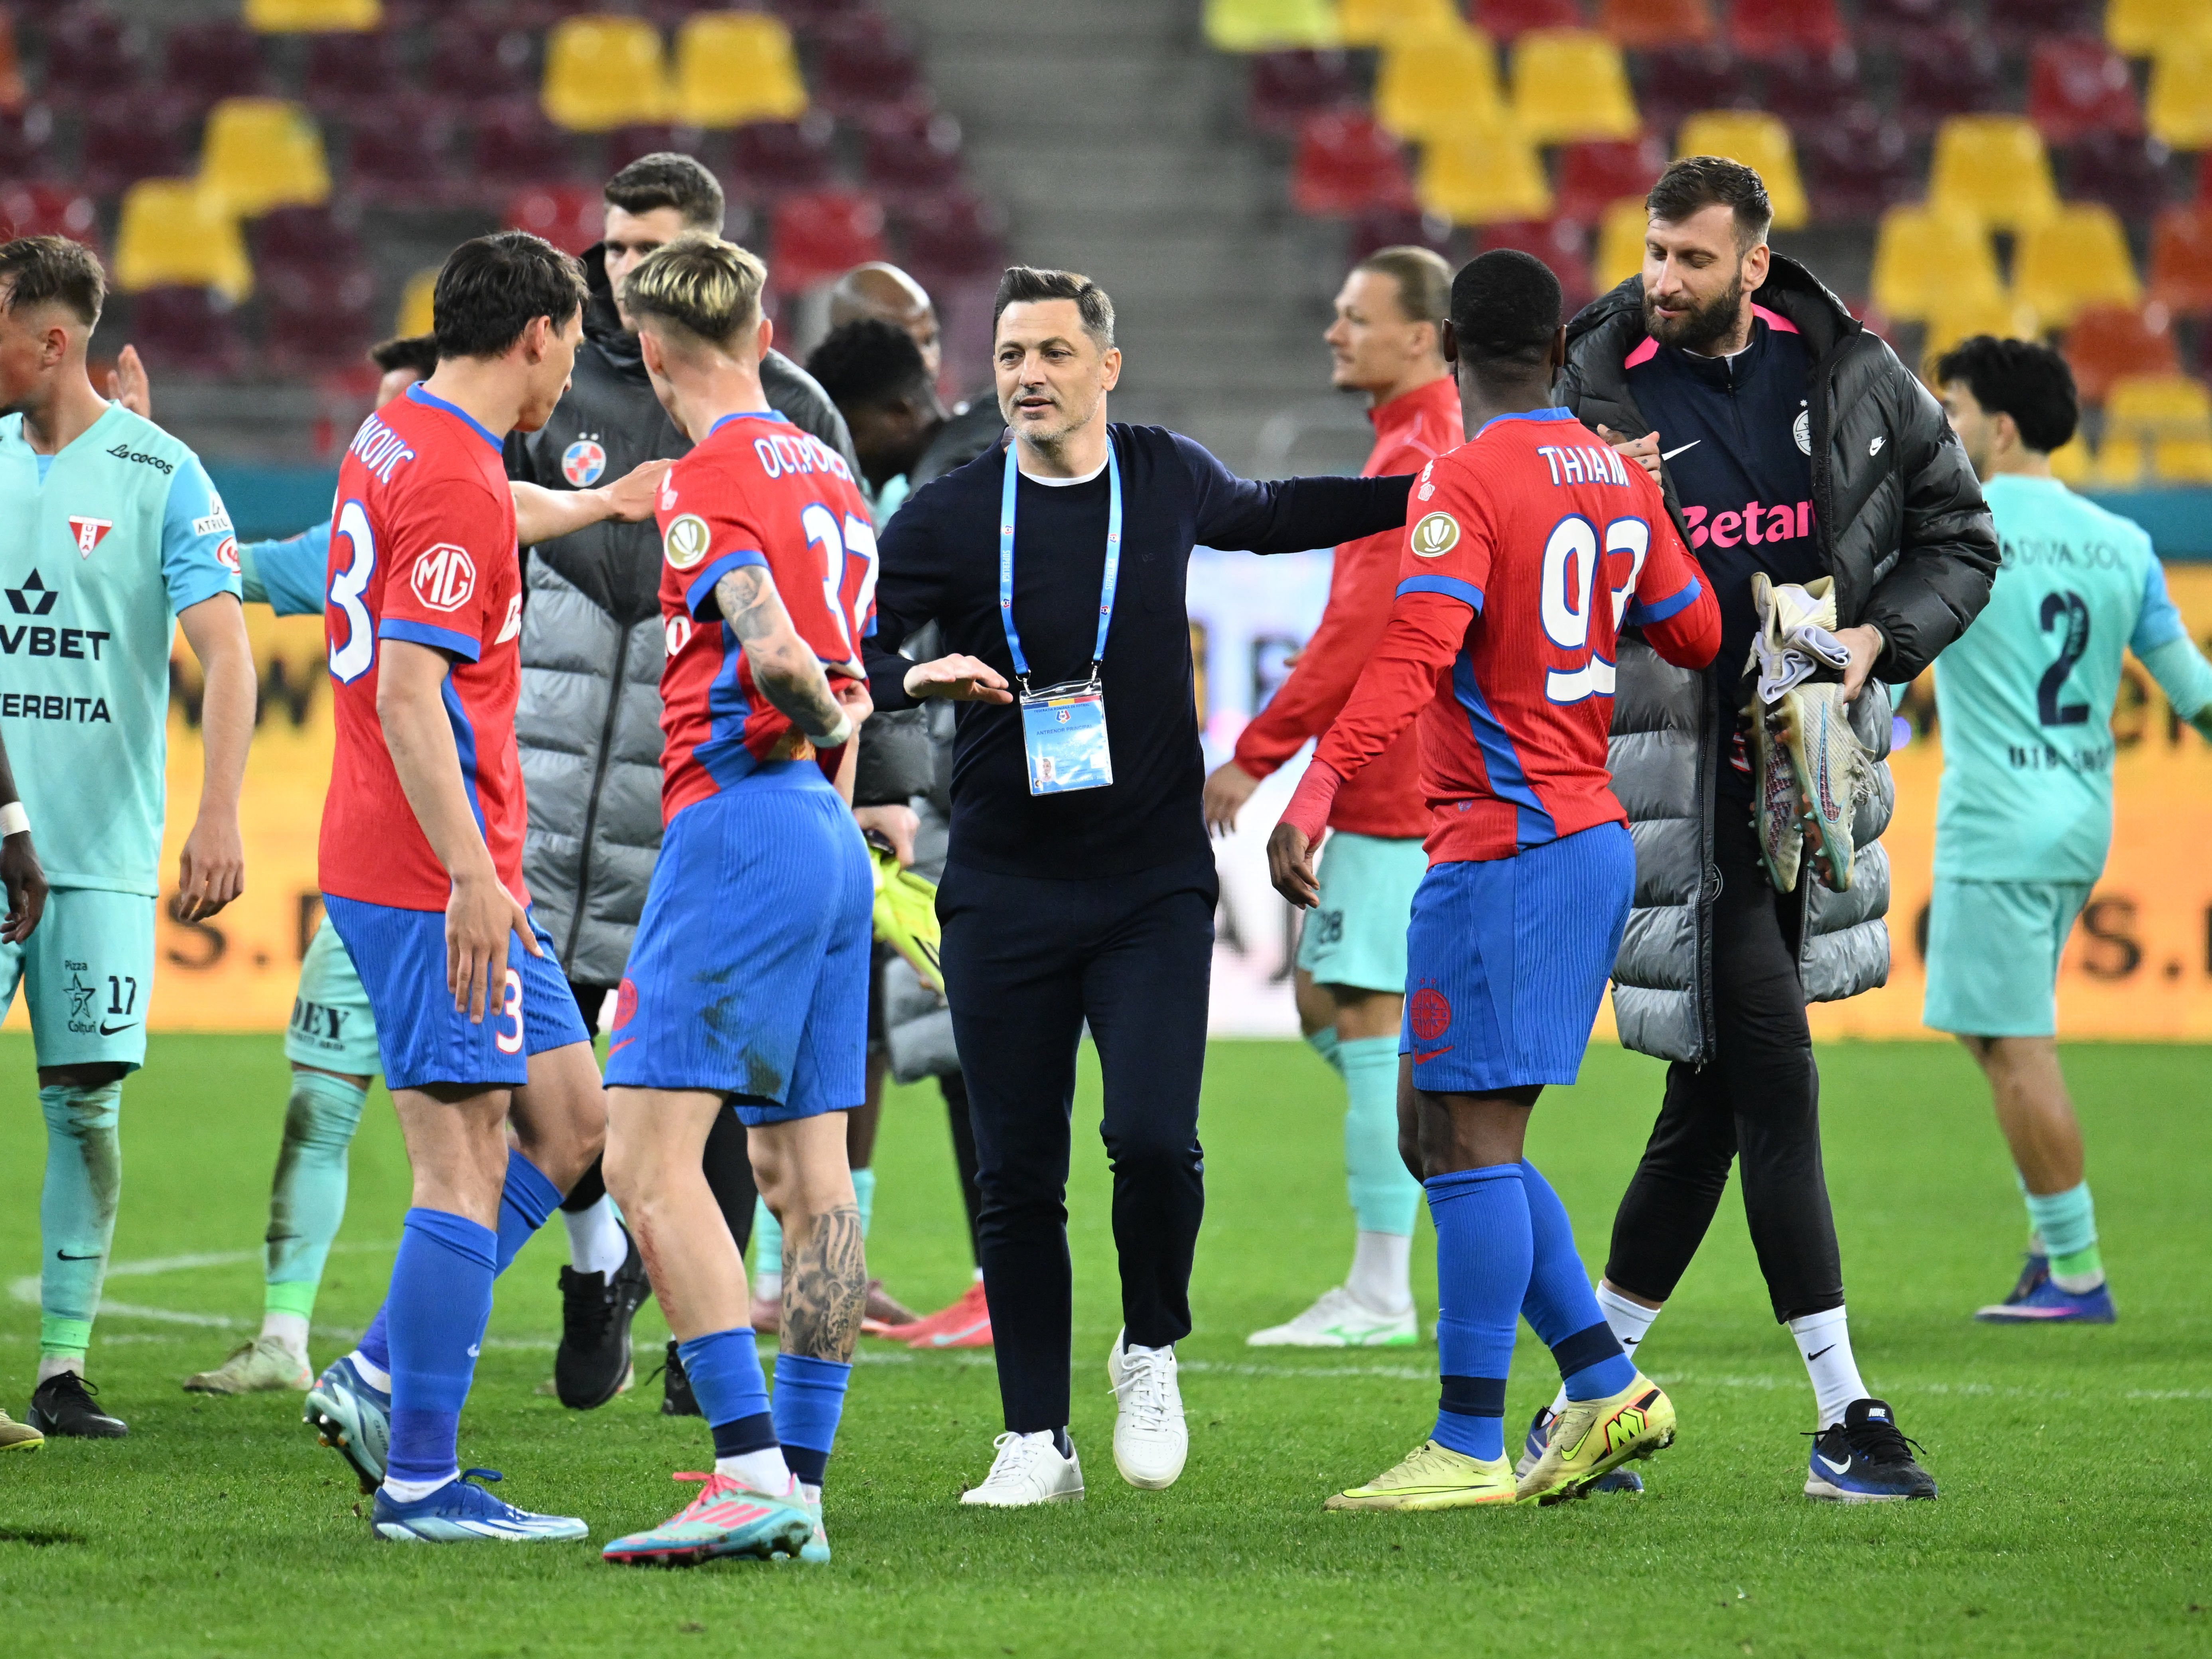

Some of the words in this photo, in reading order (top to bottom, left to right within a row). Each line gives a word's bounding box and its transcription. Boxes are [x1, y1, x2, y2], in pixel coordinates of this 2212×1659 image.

[1536, 446, 1630, 487] THIAM
[1681, 498, 1816, 549] Betan
[417, 550, 471, 605] MG
[1002, 550, 1010, 583] SUPERLIGA
[1104, 558, 1116, 591] SUPERLIGA
[1539, 513, 1651, 706] 93
[2038, 591, 2090, 726] 2
[0, 694, 111, 723] ERBITA
[1037, 727, 1065, 736] ANTRENOR
[1319, 910, 1343, 944] 28
[65, 960, 88, 971] Pizza
[108, 975, 136, 1015] 17
[1868, 1408, 1886, 1418] NIKE
